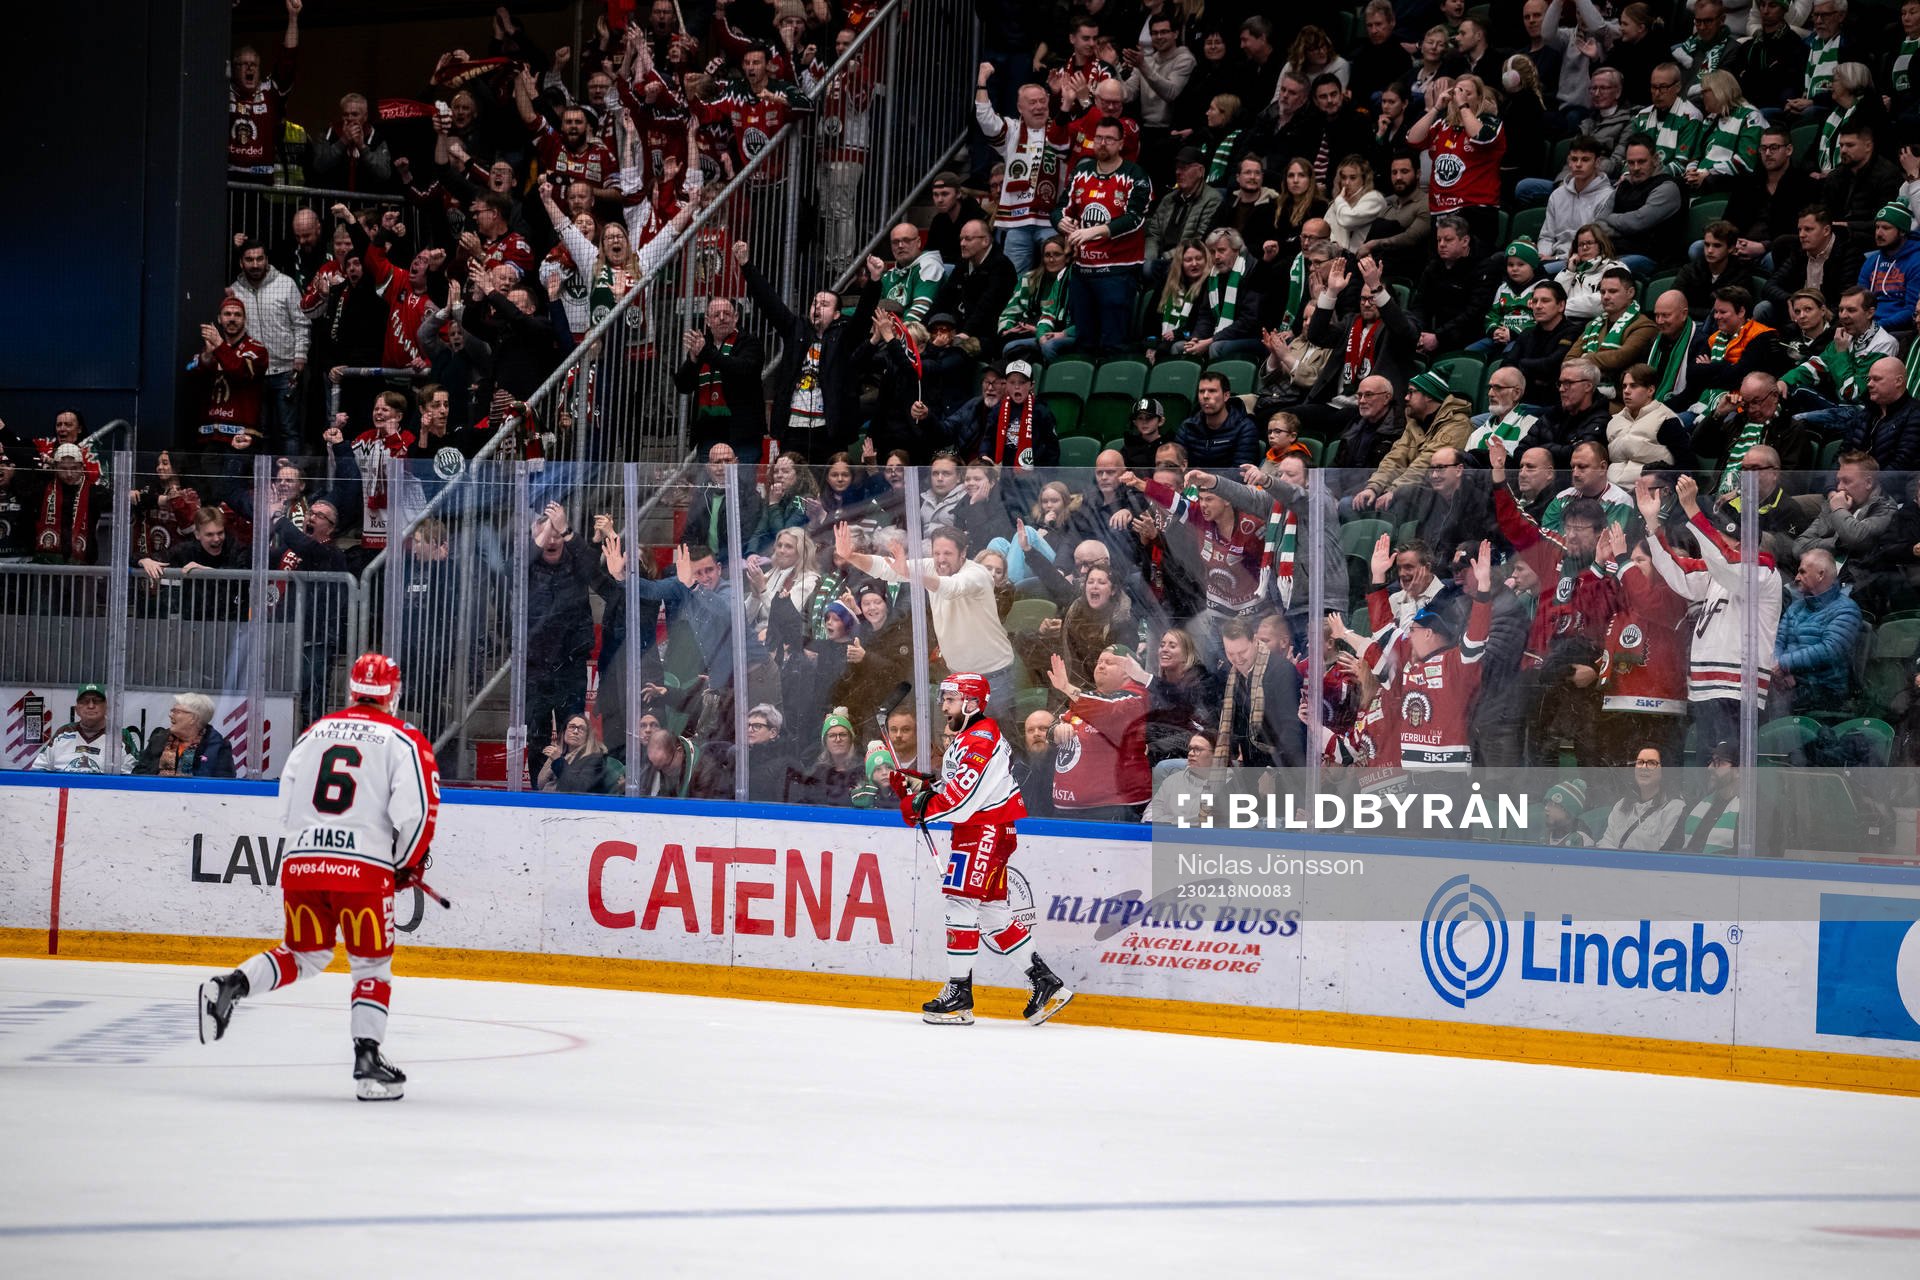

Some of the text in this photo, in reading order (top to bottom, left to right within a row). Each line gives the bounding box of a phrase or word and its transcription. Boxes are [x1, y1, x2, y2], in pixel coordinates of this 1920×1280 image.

[1080, 250, 1109, 260] RASTA
[1634, 699, 1665, 708] SKF
[314, 729, 386, 745] WELLNESS
[327, 721, 377, 734] NORDIC
[1423, 752, 1454, 762] SKF
[312, 743, 363, 815] 6
[955, 762, 980, 791] 28
[313, 828, 356, 850] HASA
[973, 824, 997, 873] STENA
[289, 860, 361, 877] eyes4work
[587, 840, 895, 944] CATENA
[382, 896, 395, 949] ENA
[1047, 894, 1302, 937] KLIPPANS BUSS
[1121, 931, 1262, 957] ÄNGELHOLM
[1521, 911, 1730, 996] Lindab
[1100, 951, 1263, 975] HELSINGBORG
